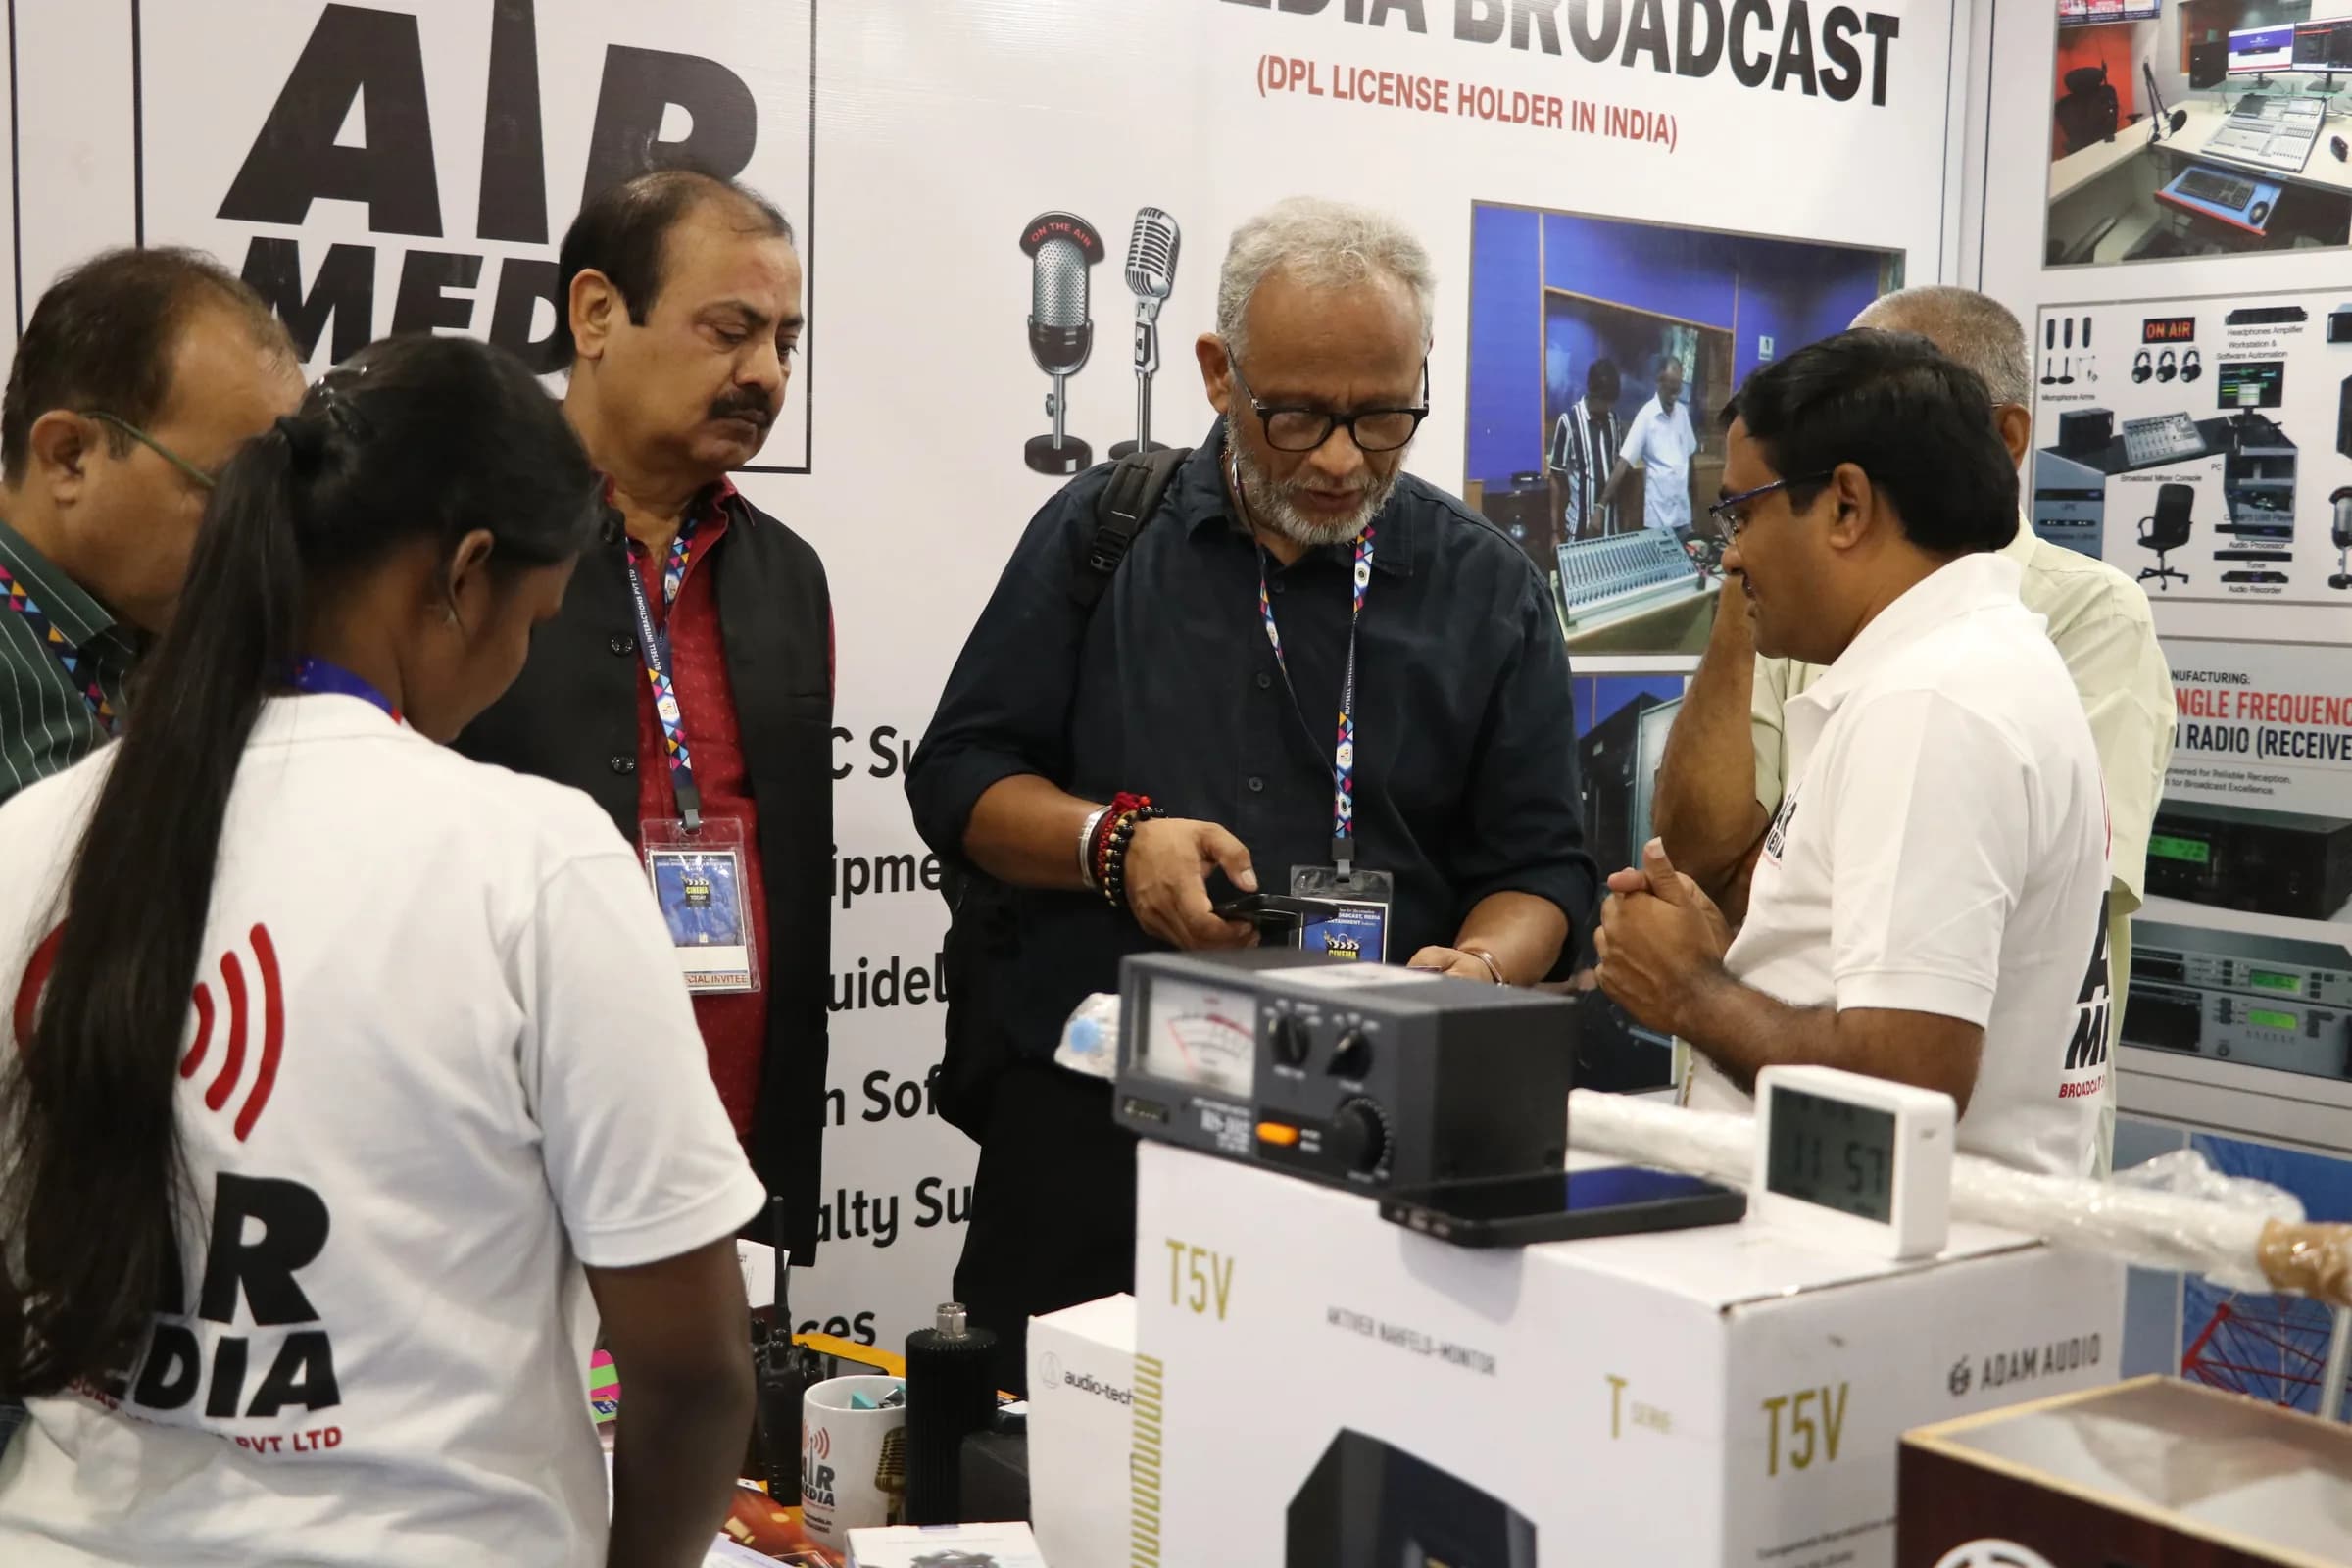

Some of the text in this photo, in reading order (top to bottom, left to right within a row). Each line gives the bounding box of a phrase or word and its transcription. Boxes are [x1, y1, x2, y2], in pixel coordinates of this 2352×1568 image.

[1257, 55, 1677, 154] (DPL LICENSE HOLDER IN INDIA)
[1031, 222, 1093, 248] ON THE AIR
[2146, 322, 2191, 339] ON AIR
[2227, 326, 2304, 338] Headphones Amplifier
[2229, 340, 2268, 349] Workstation
[632, 582, 641, 596] PVT
[635, 596, 654, 643] INTERACTIONS
[648, 644, 662, 671] BUYSELL
[2175, 688, 2352, 727] NGLE FREQUENC
[2186, 724, 2250, 754] RADIO
[2257, 726, 2352, 761] (RECEIVE
[2172, 778, 2183, 787] for
[2184, 779, 2227, 791] Broadcast
[2199, 768, 2211, 777] for
[2212, 769, 2245, 780] Reliable
[686, 886, 709, 895] CINEMA
[1328, 949, 1357, 959] CINEMA
[711, 974, 747, 983] INVITEE
[1164, 1238, 1234, 1321] T5V
[1980, 1332, 2101, 1392] ADAM AUDIO
[1604, 1373, 1629, 1440] T
[293, 1425, 343, 1453] LTD
[1761, 1381, 1850, 1477] T5V
